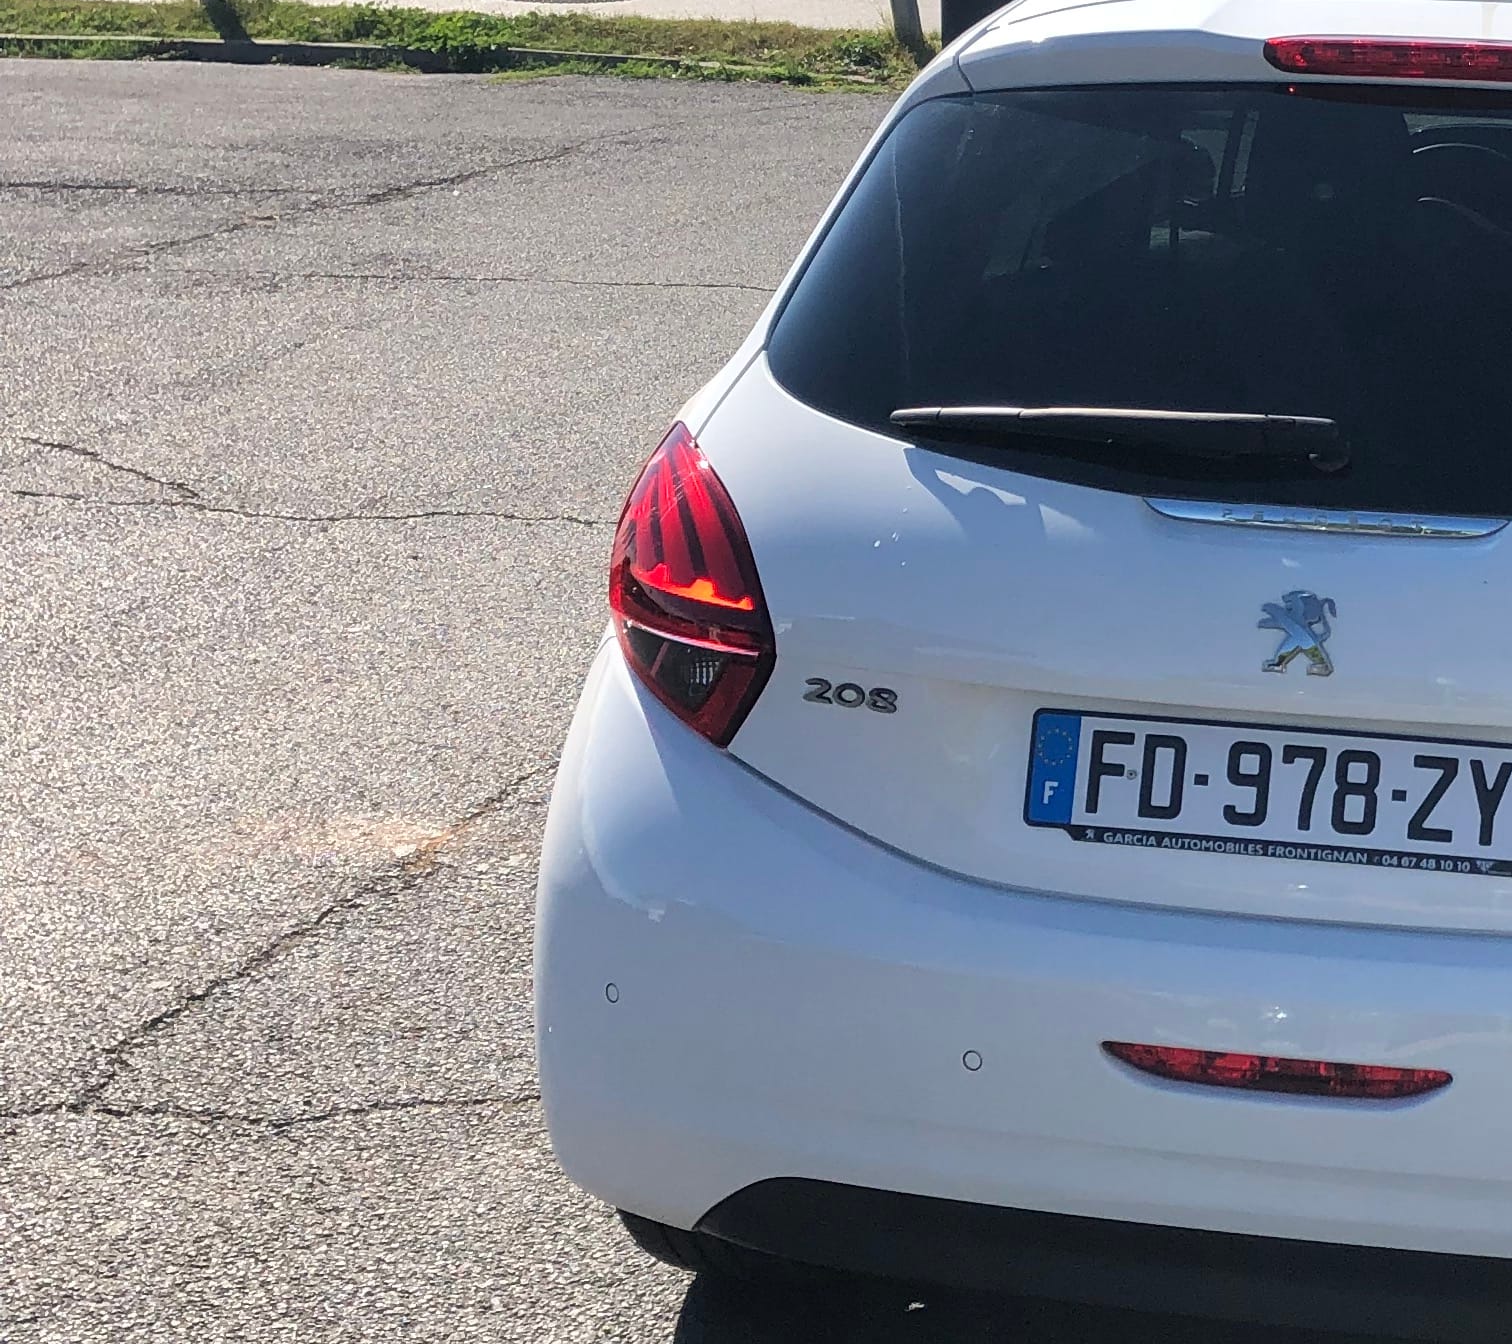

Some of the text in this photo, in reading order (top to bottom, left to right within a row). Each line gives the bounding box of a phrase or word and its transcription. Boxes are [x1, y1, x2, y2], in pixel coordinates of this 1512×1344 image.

[802, 677, 898, 714] 208
[1043, 781, 1059, 804] F
[1103, 832, 1157, 847] GARCIA
[1161, 837, 1263, 856] AUTOMOBILES
[1267, 845, 1368, 864] FRONTIGNAN
[1382, 855, 1398, 866] 04
[1420, 858, 1436, 869] 48
[1440, 860, 1453, 871] 10
[1457, 861, 1471, 872] 10
